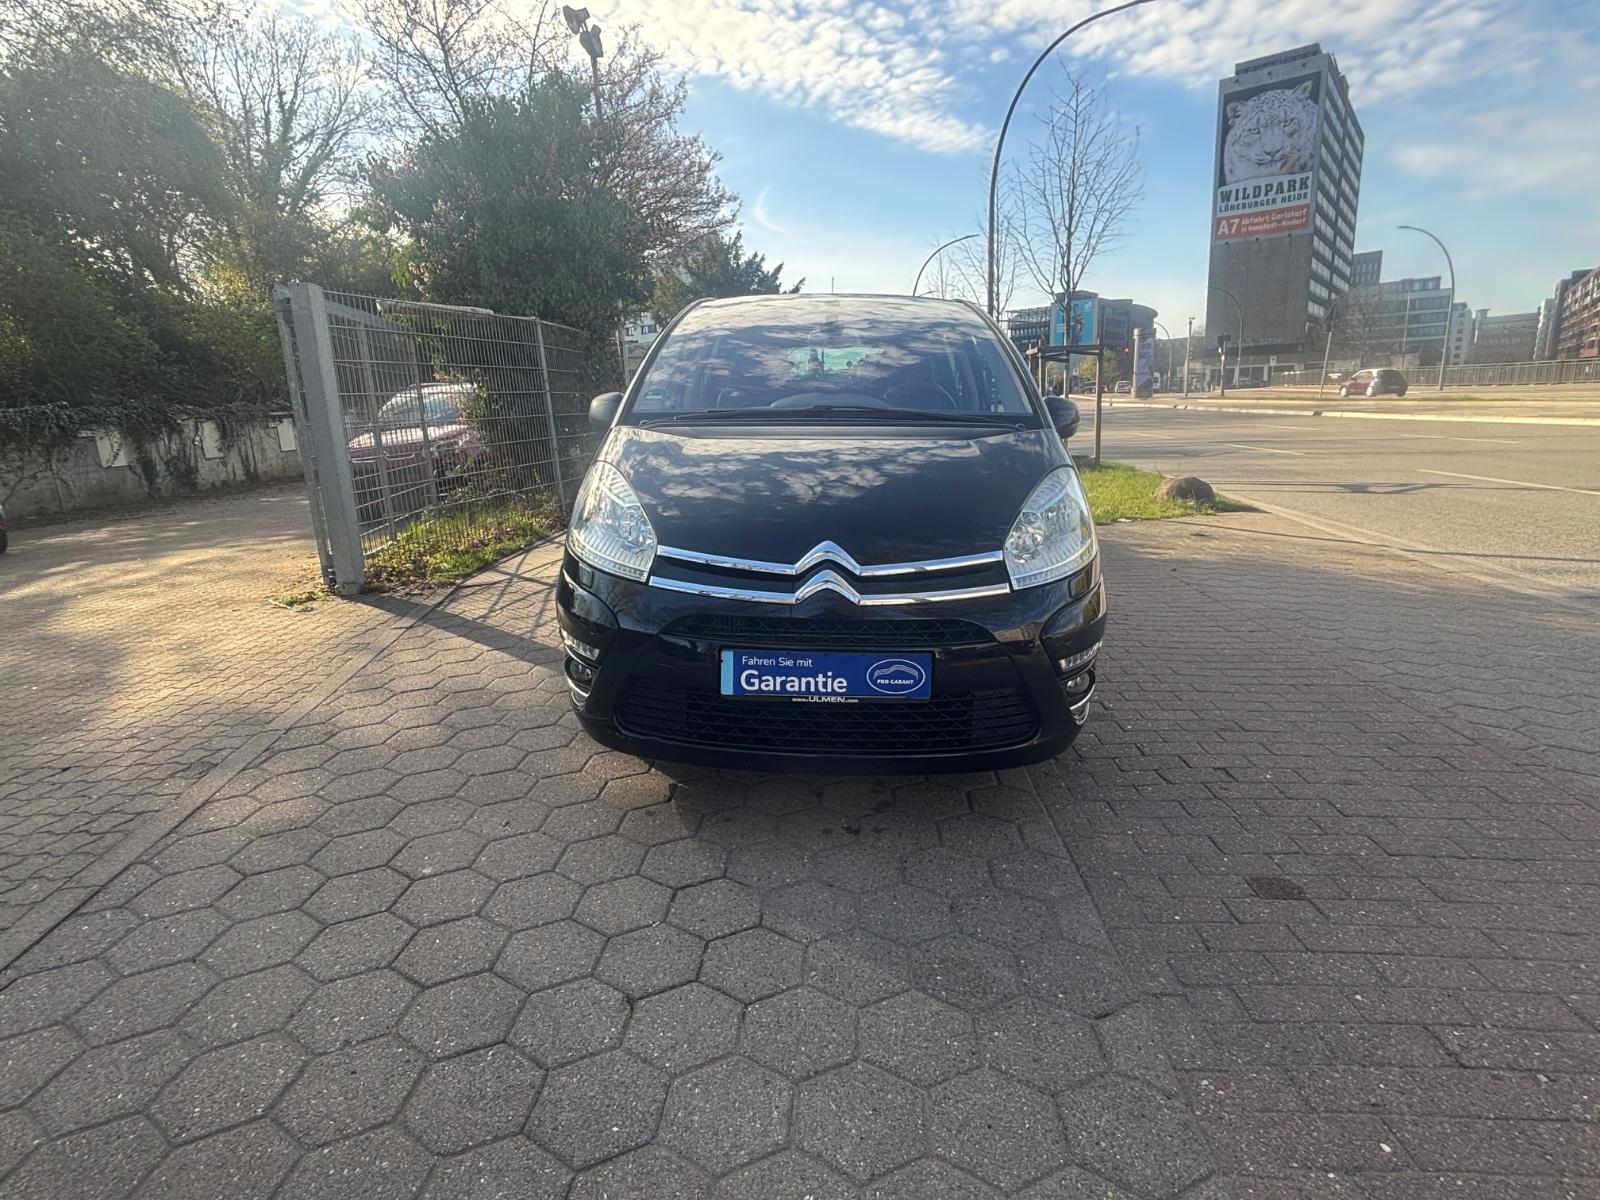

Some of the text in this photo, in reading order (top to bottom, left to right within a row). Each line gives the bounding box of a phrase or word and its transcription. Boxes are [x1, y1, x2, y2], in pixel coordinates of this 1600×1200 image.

[1219, 176, 1310, 203] WILDPARK
[1219, 192, 1308, 213] LÜNEBURGER HEIDE
[1217, 218, 1240, 235] A7
[742, 656, 813, 667] Fahren Sie mit
[740, 669, 847, 692] Garantie
